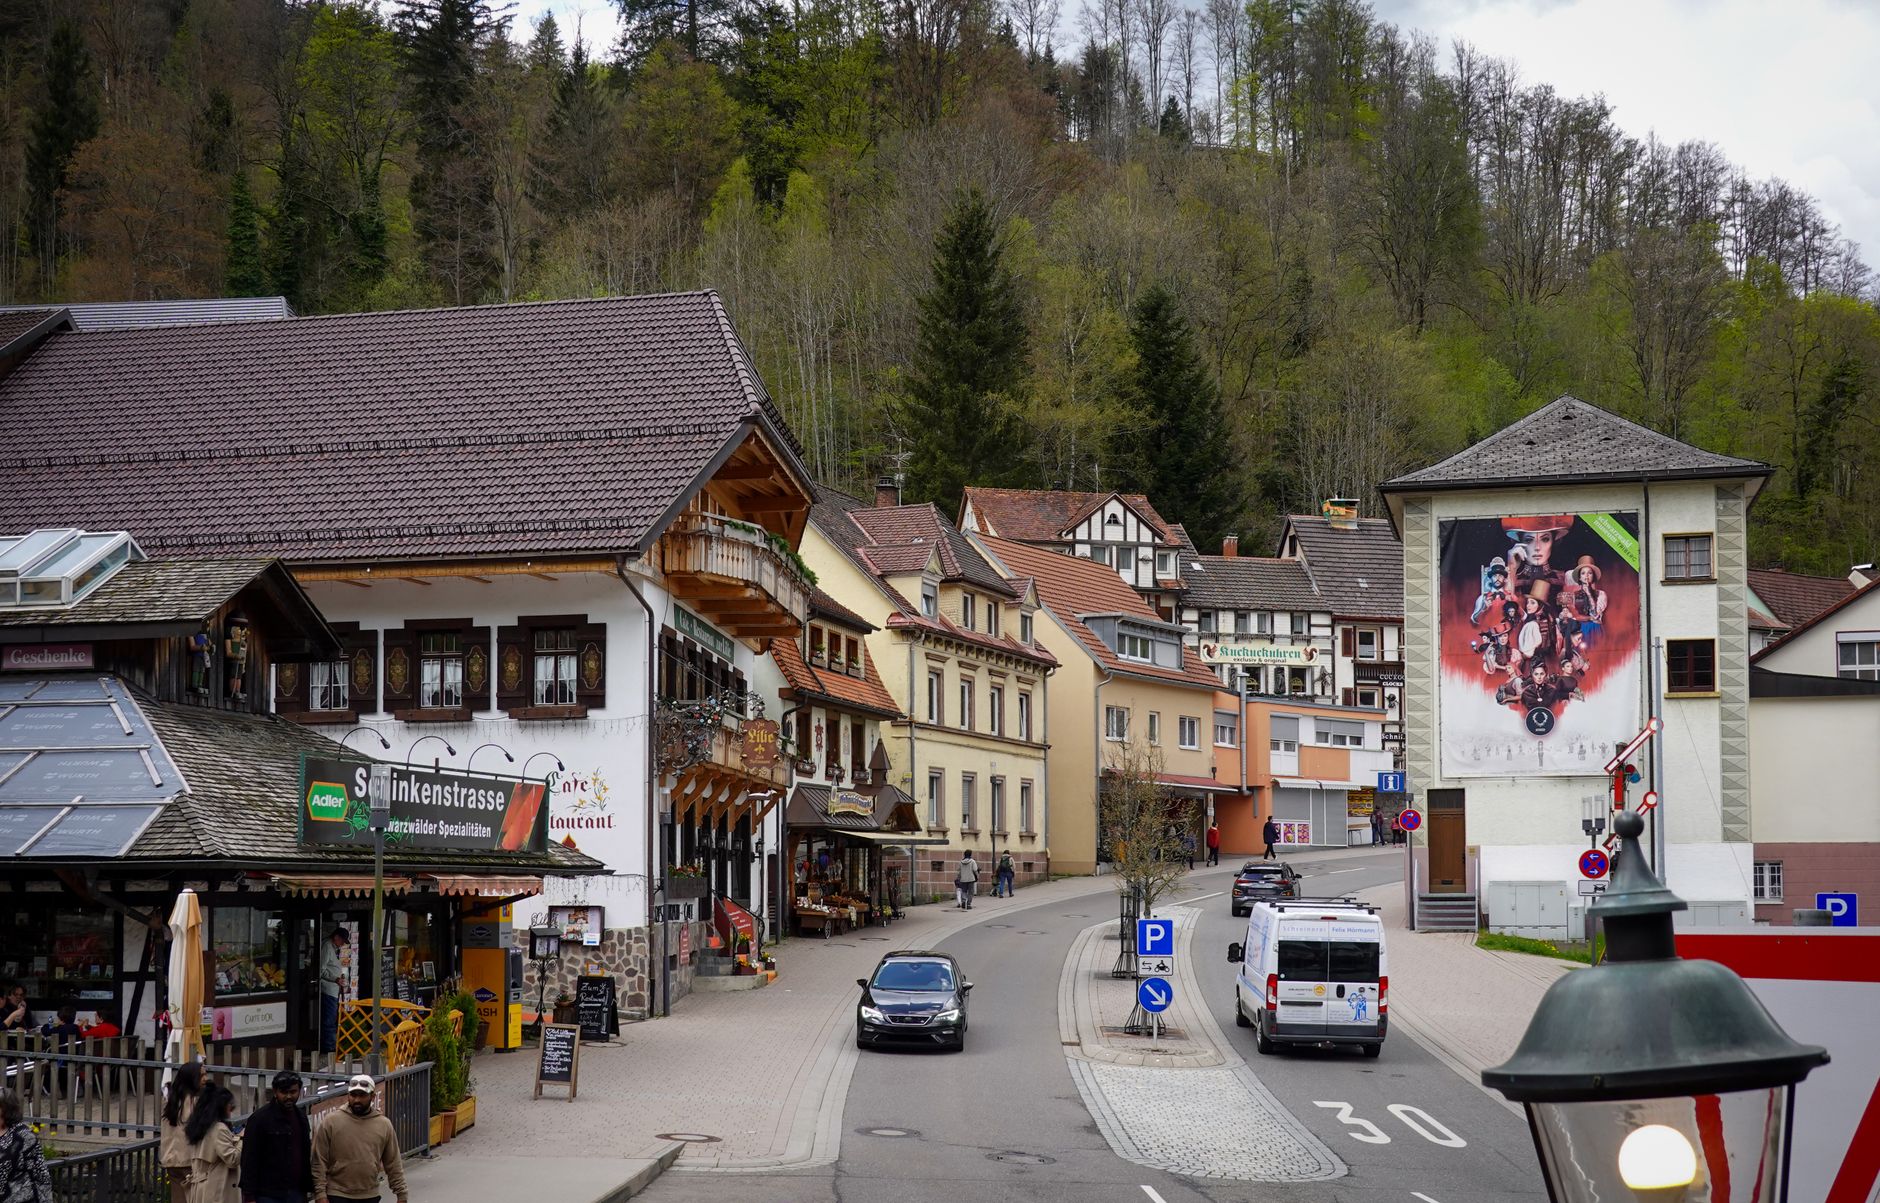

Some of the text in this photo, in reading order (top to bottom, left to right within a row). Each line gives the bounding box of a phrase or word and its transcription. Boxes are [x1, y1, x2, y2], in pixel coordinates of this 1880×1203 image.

[10, 647, 86, 664] Geschenke
[1219, 646, 1301, 659] Kuckuckuhren
[312, 794, 344, 808] Adler
[439, 820, 491, 839] Spezialitäten
[1145, 923, 1166, 951] P
[581, 982, 599, 991] Zum
[477, 1008, 498, 1016] ASH
[1312, 1100, 1468, 1148] 30
